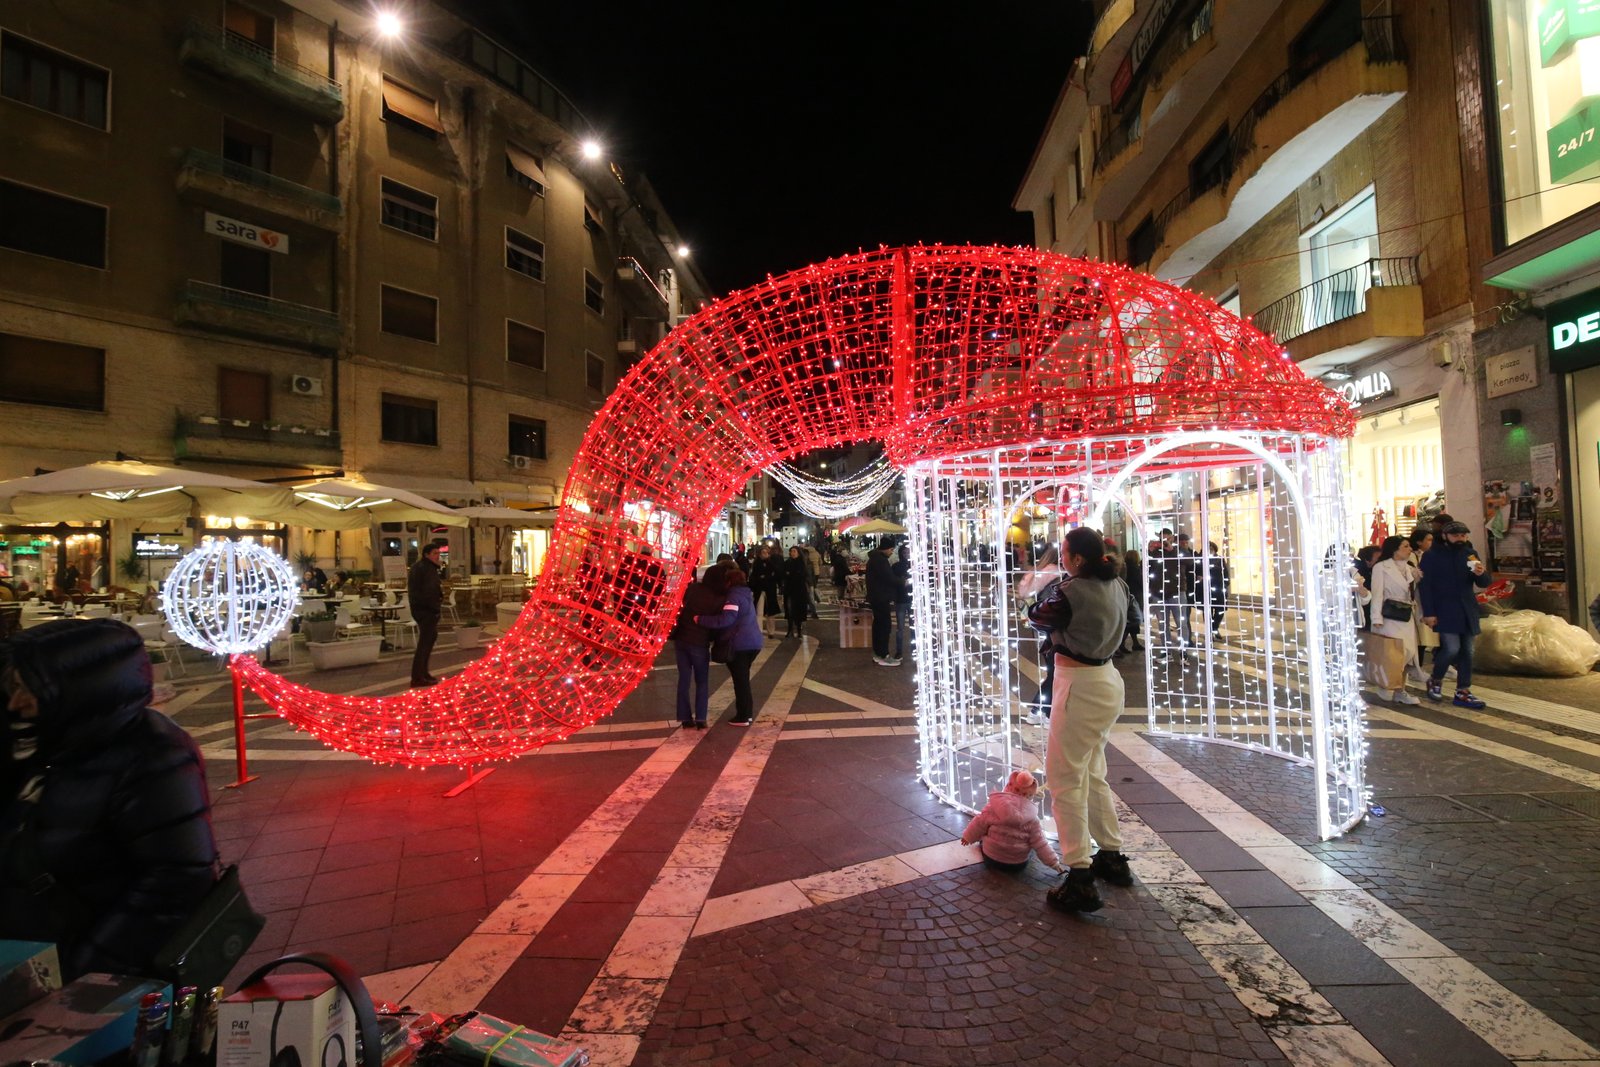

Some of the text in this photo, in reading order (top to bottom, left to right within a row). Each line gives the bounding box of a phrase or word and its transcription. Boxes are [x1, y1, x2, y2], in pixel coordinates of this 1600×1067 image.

[1557, 127, 1595, 158] 24/7
[216, 220, 257, 241] sara
[1500, 359, 1520, 370] piazza
[1493, 371, 1530, 388] Kennedy
[231, 1020, 249, 1030] P47
